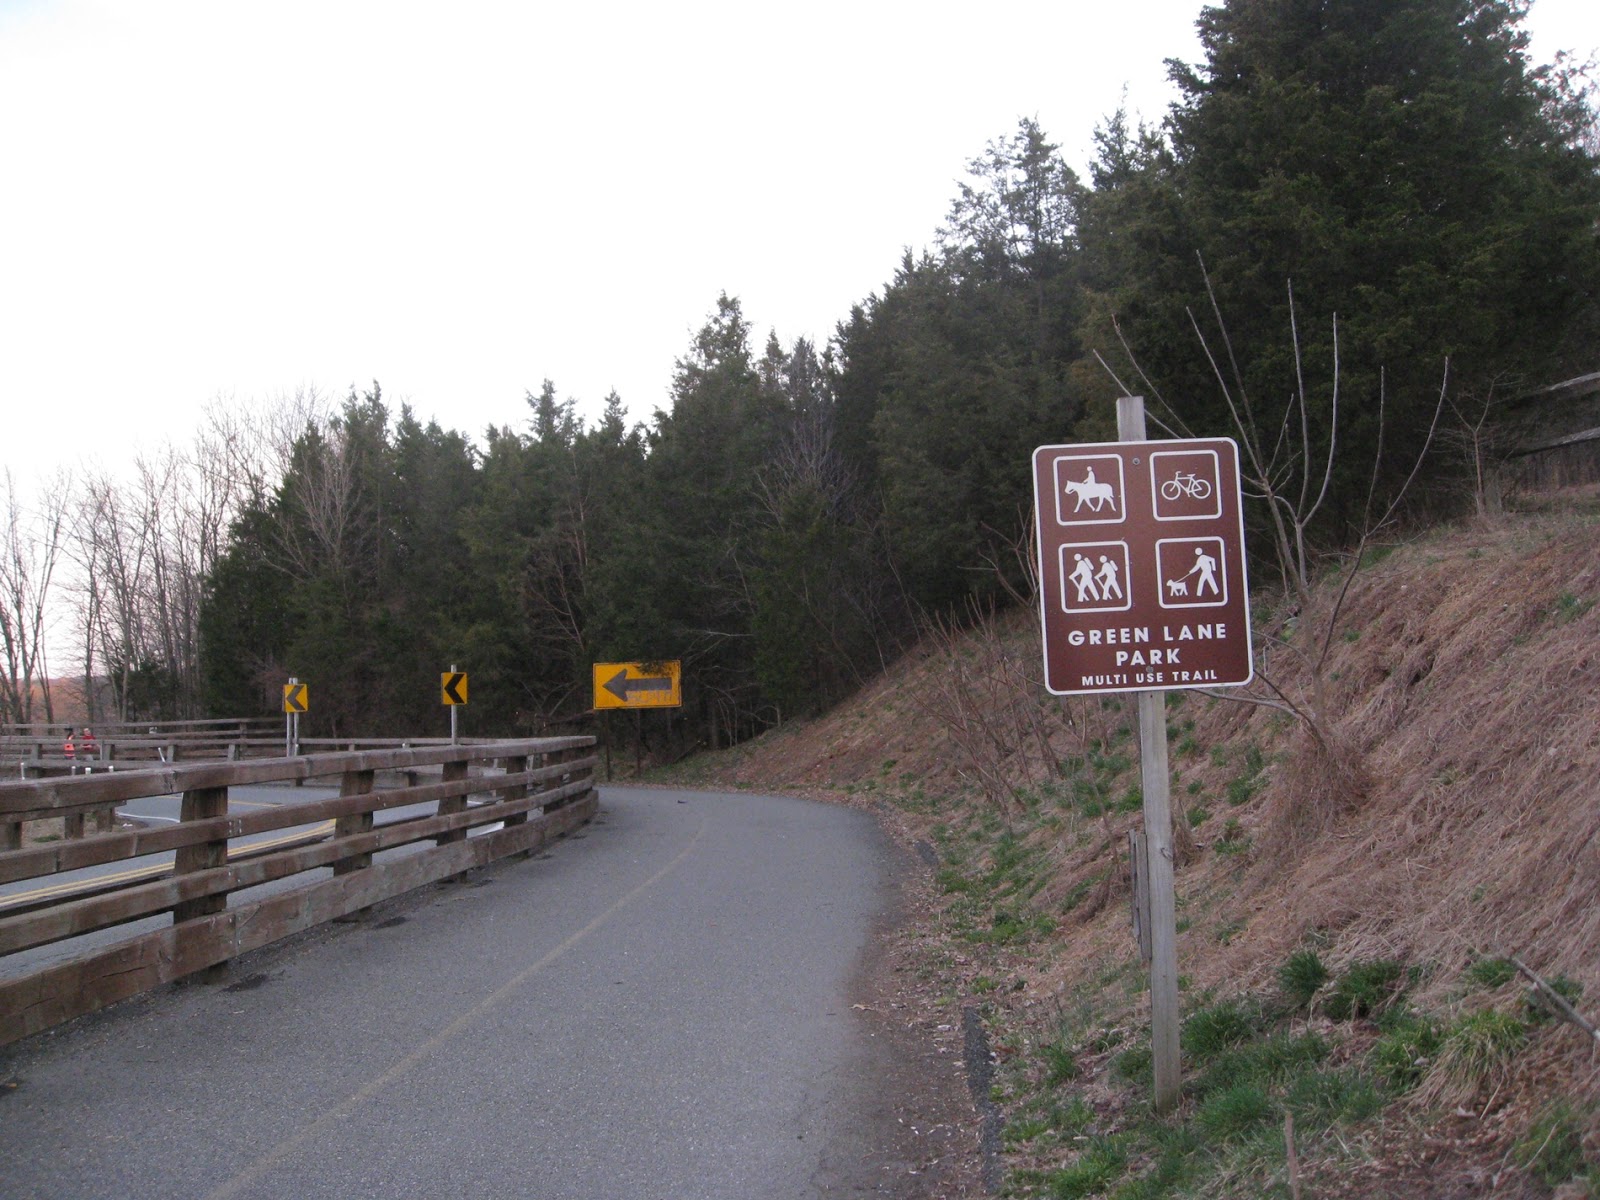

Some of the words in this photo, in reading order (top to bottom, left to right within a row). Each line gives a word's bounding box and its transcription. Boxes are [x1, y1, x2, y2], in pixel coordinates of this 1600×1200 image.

[1068, 627, 1149, 646] GREEN
[1163, 623, 1227, 642] LANE
[1116, 648, 1181, 667] PARK
[1081, 674, 1127, 686] MULTI
[1136, 672, 1164, 683] USE
[1172, 669, 1218, 682] TRAIL
